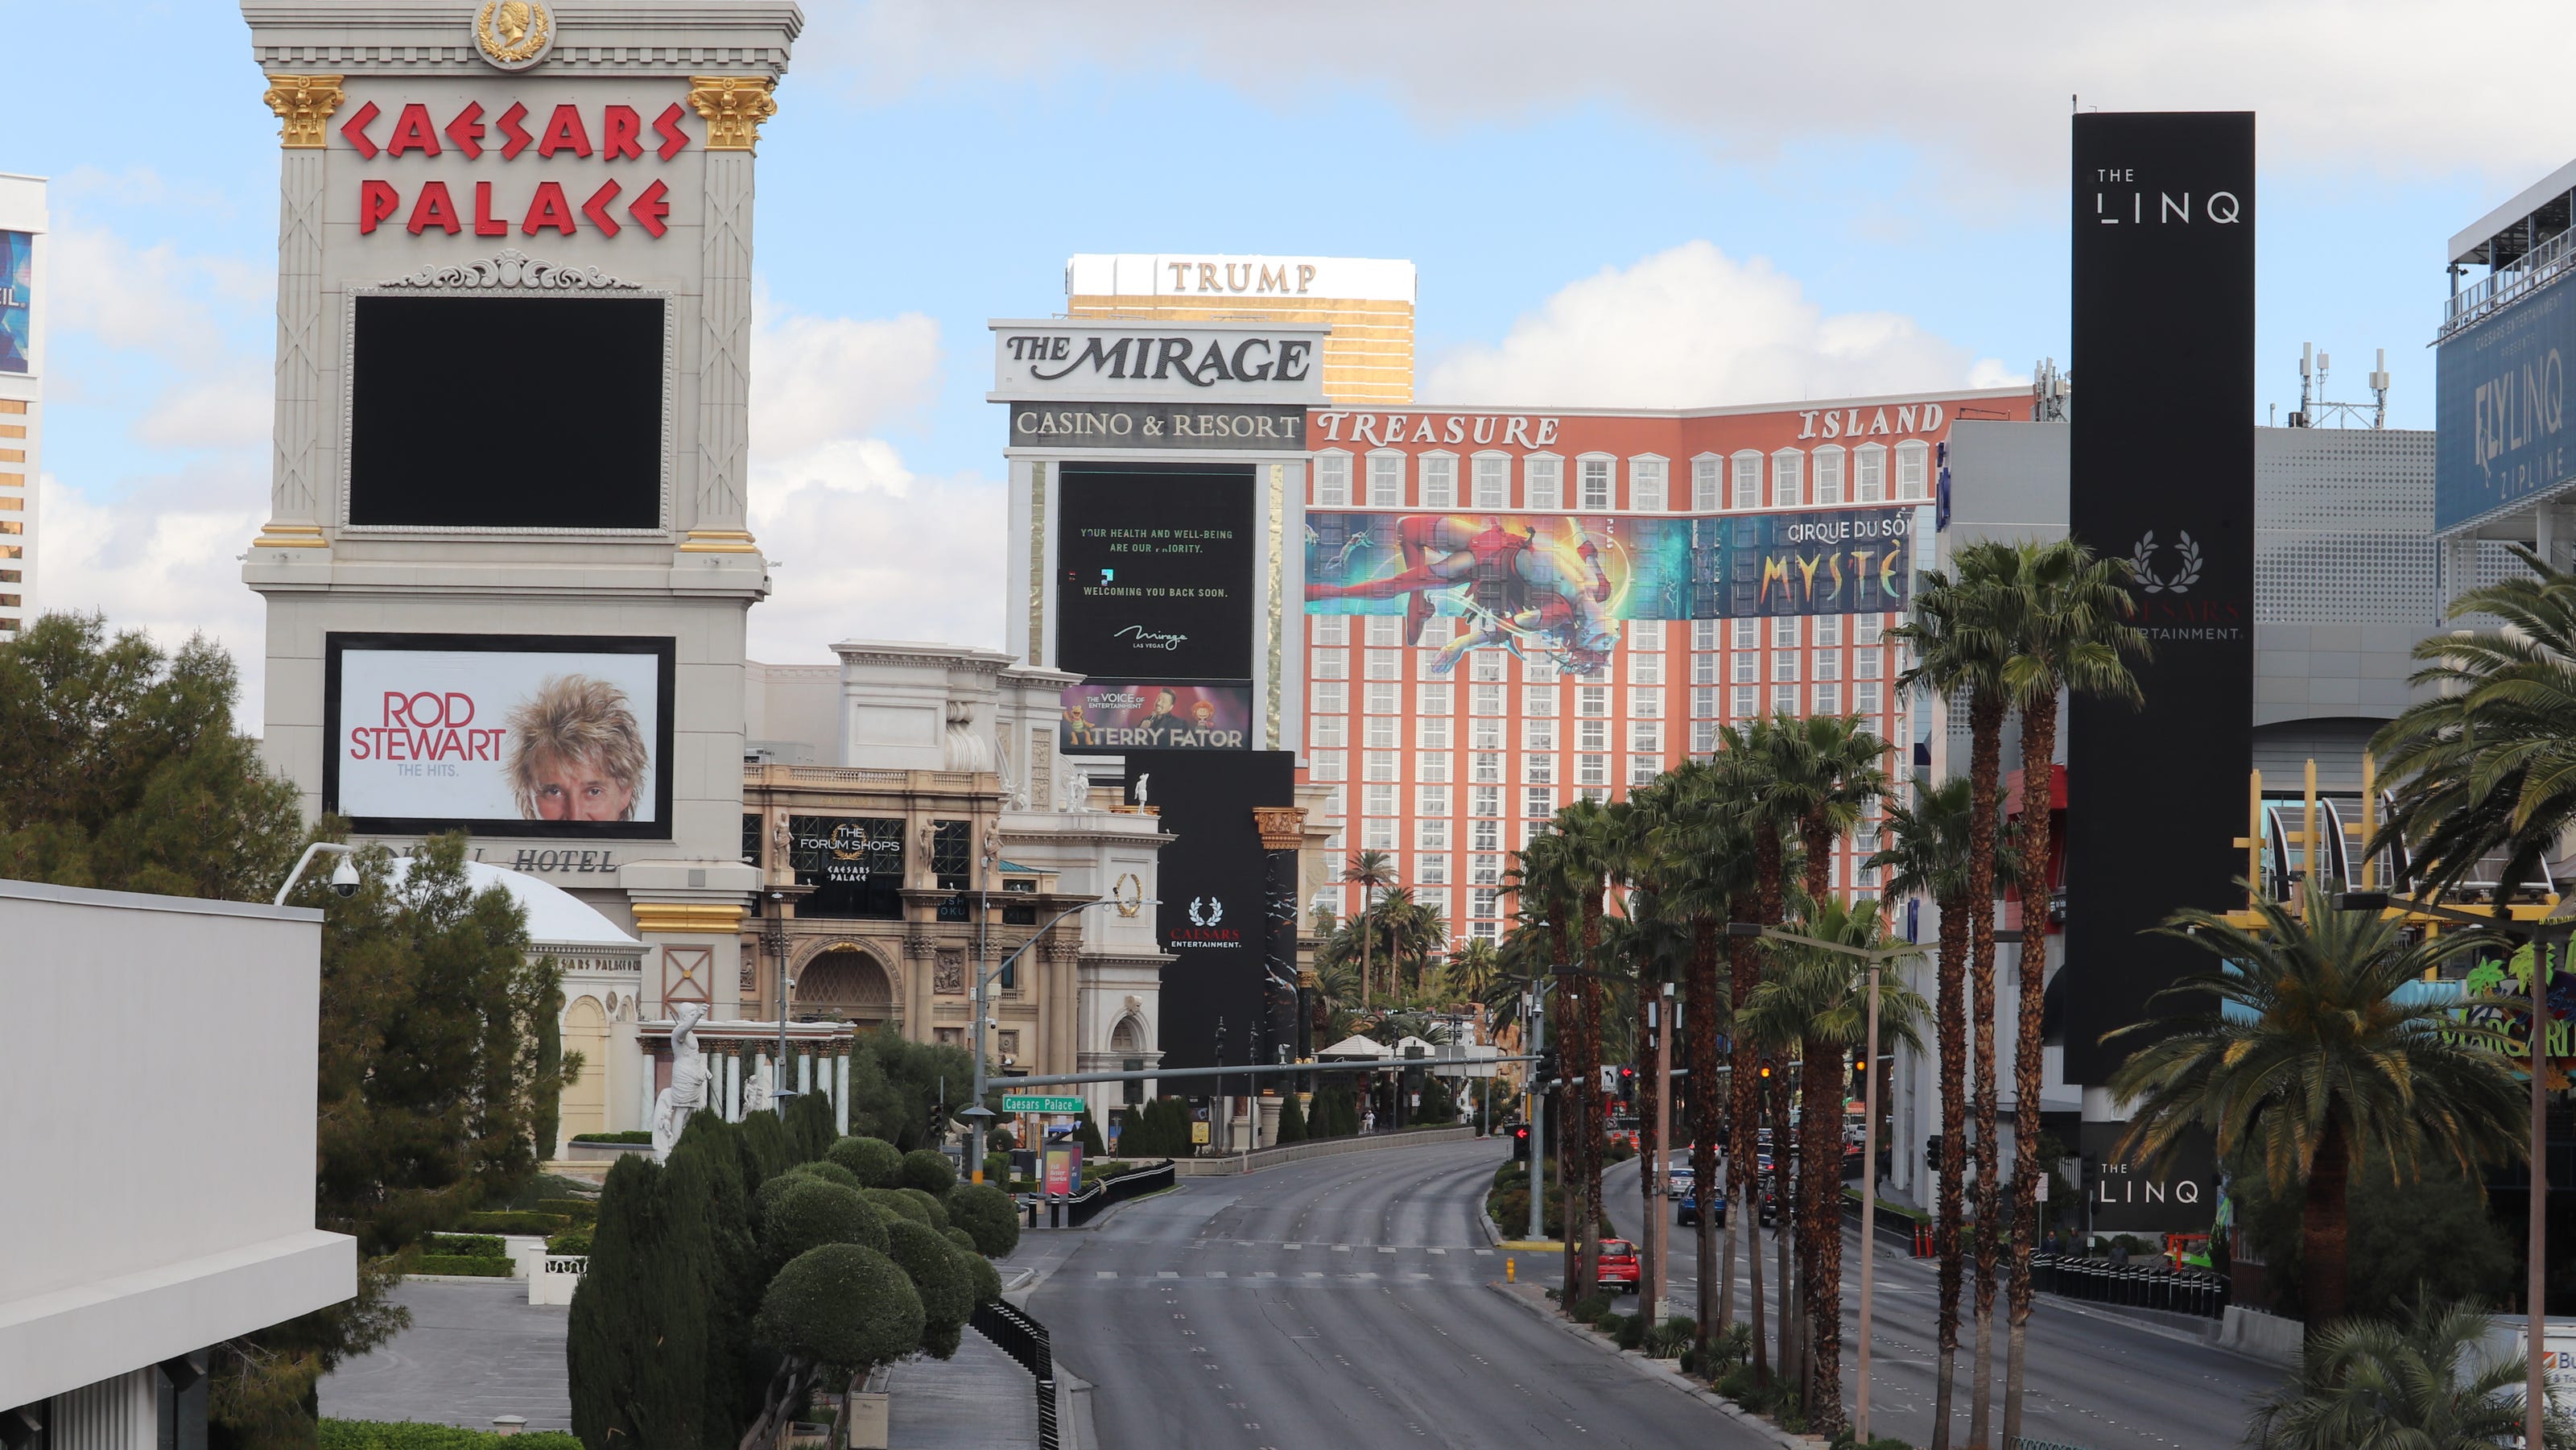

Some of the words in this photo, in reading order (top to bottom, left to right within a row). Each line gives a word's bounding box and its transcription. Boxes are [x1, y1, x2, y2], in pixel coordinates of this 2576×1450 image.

[341, 101, 691, 161] CAESARS
[2097, 169, 2133, 182] THE
[361, 179, 670, 238] PALACE
[2097, 191, 2240, 224] LINQ
[1169, 262, 1316, 292] TRUMP
[1006, 336, 1070, 361] THE
[1030, 337, 1311, 387] MIRAGE
[1016, 411, 1133, 436] CASINO
[1142, 415, 1165, 436] &
[1173, 414, 1300, 439] RESORT
[1316, 411, 1560, 450] TREASURE
[1798, 403, 1943, 440] ISLAND
[2500, 447, 2563, 500] ZIPLINE
[1081, 528, 1107, 538] YOUR
[1110, 528, 1147, 538] HEALTH
[1150, 529, 1170, 538] AND
[1174, 530, 1233, 539] WELL-BEING
[1788, 522, 1850, 544] CIRQUE
[1854, 520, 1878, 538] DU
[1109, 543, 1128, 552] ARE
[1132, 543, 1151, 552] OUR
[1084, 586, 1142, 597] WELCOMING
[1146, 588, 1166, 597] YOU
[1169, 588, 1195, 597] BACK
[1198, 589, 1228, 597] SOON.
[1100, 693, 1134, 703] VOICE
[383, 692, 475, 728] ROD
[350, 726, 506, 761] STEWART
[1090, 727, 1165, 746] TERRY
[1170, 728, 1243, 748] FATOR
[397, 764, 422, 777] THE
[427, 764, 460, 777] HITS.
[837, 827, 865, 838] THE
[800, 838, 849, 850] FORUM
[852, 840, 901, 852] SHOPS
[513, 849, 621, 873] HOTEL
[827, 865, 870, 874] CAESARS
[830, 874, 866, 882] PALACE
[1170, 927, 1241, 940] CAESARS
[1171, 940, 1240, 948] ENTERTAINMENT
[1005, 1098, 1039, 1109] Caesars
[1044, 1099, 1073, 1110] Palace
[2101, 1163, 2128, 1174] THE
[2100, 1180, 2198, 1204] LINQ
